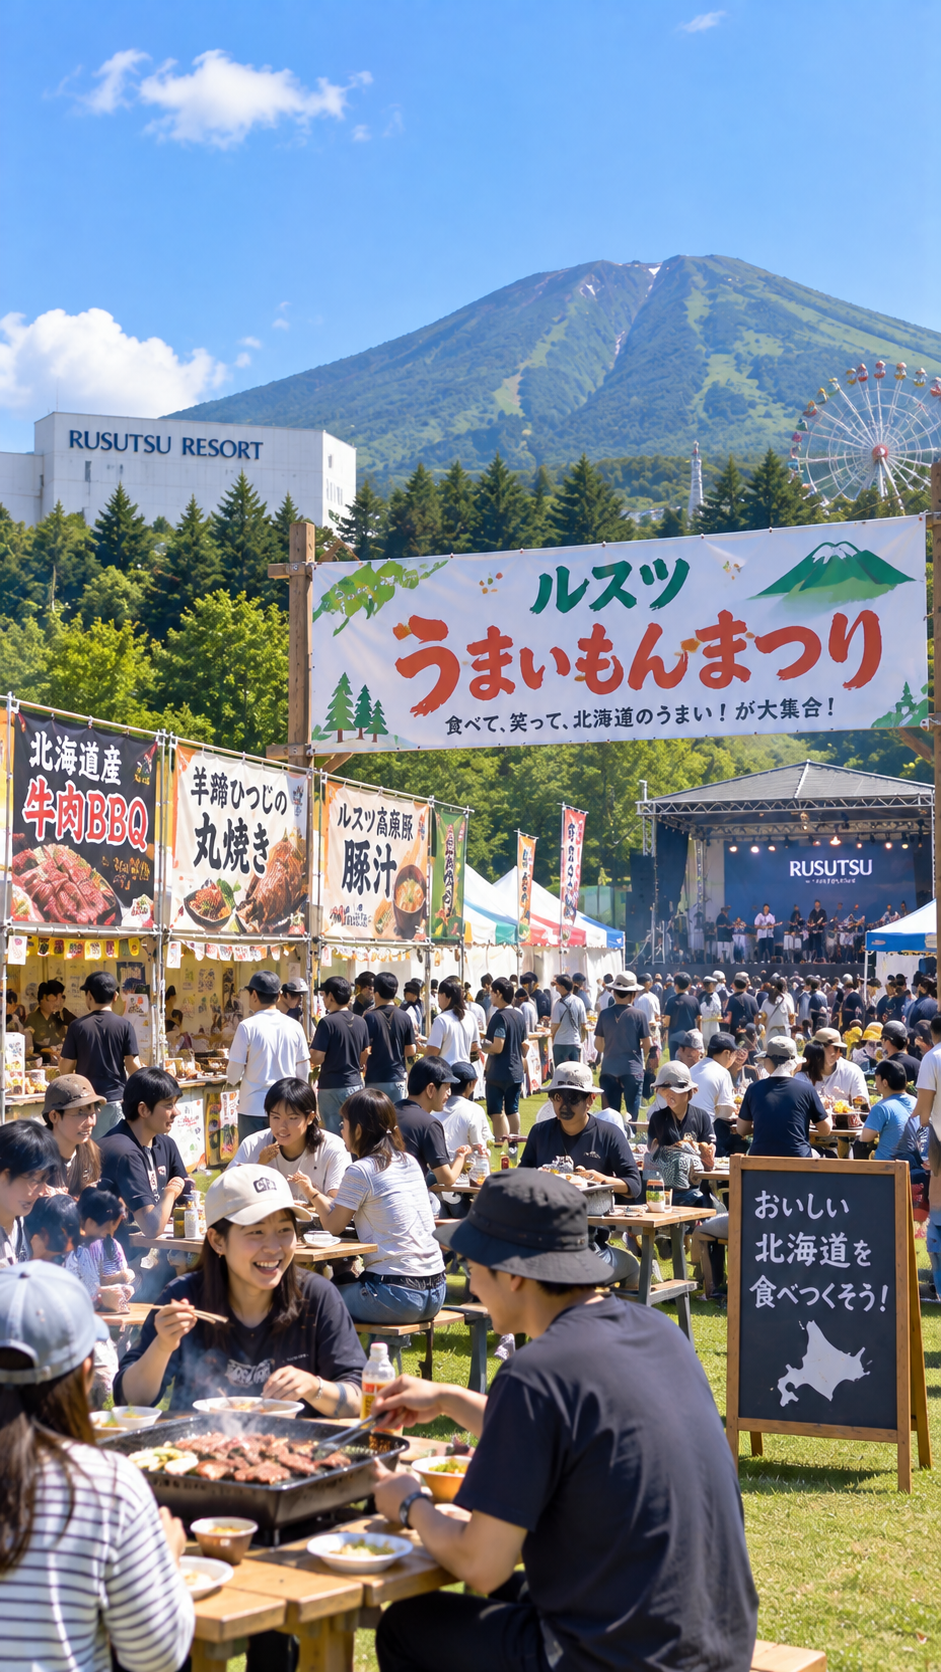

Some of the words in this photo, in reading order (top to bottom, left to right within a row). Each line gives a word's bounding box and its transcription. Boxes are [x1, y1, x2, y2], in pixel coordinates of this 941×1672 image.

[69, 429, 172, 454] RUSUTSU
[182, 437, 264, 460] RESORT
[530, 557, 691, 615] ルスツ
[394, 609, 882, 717] うまいもんまつり
[29, 731, 123, 785] 北海道産
[22, 775, 149, 853] 牛肉BBQ
[193, 811, 270, 875] 丸焼き
[789, 859, 873, 877] RUSUTSU
[754, 1190, 850, 1220] おいしい
[754, 1232, 872, 1268] 北海道を
[749, 1274, 890, 1312] 食べつくそう！
